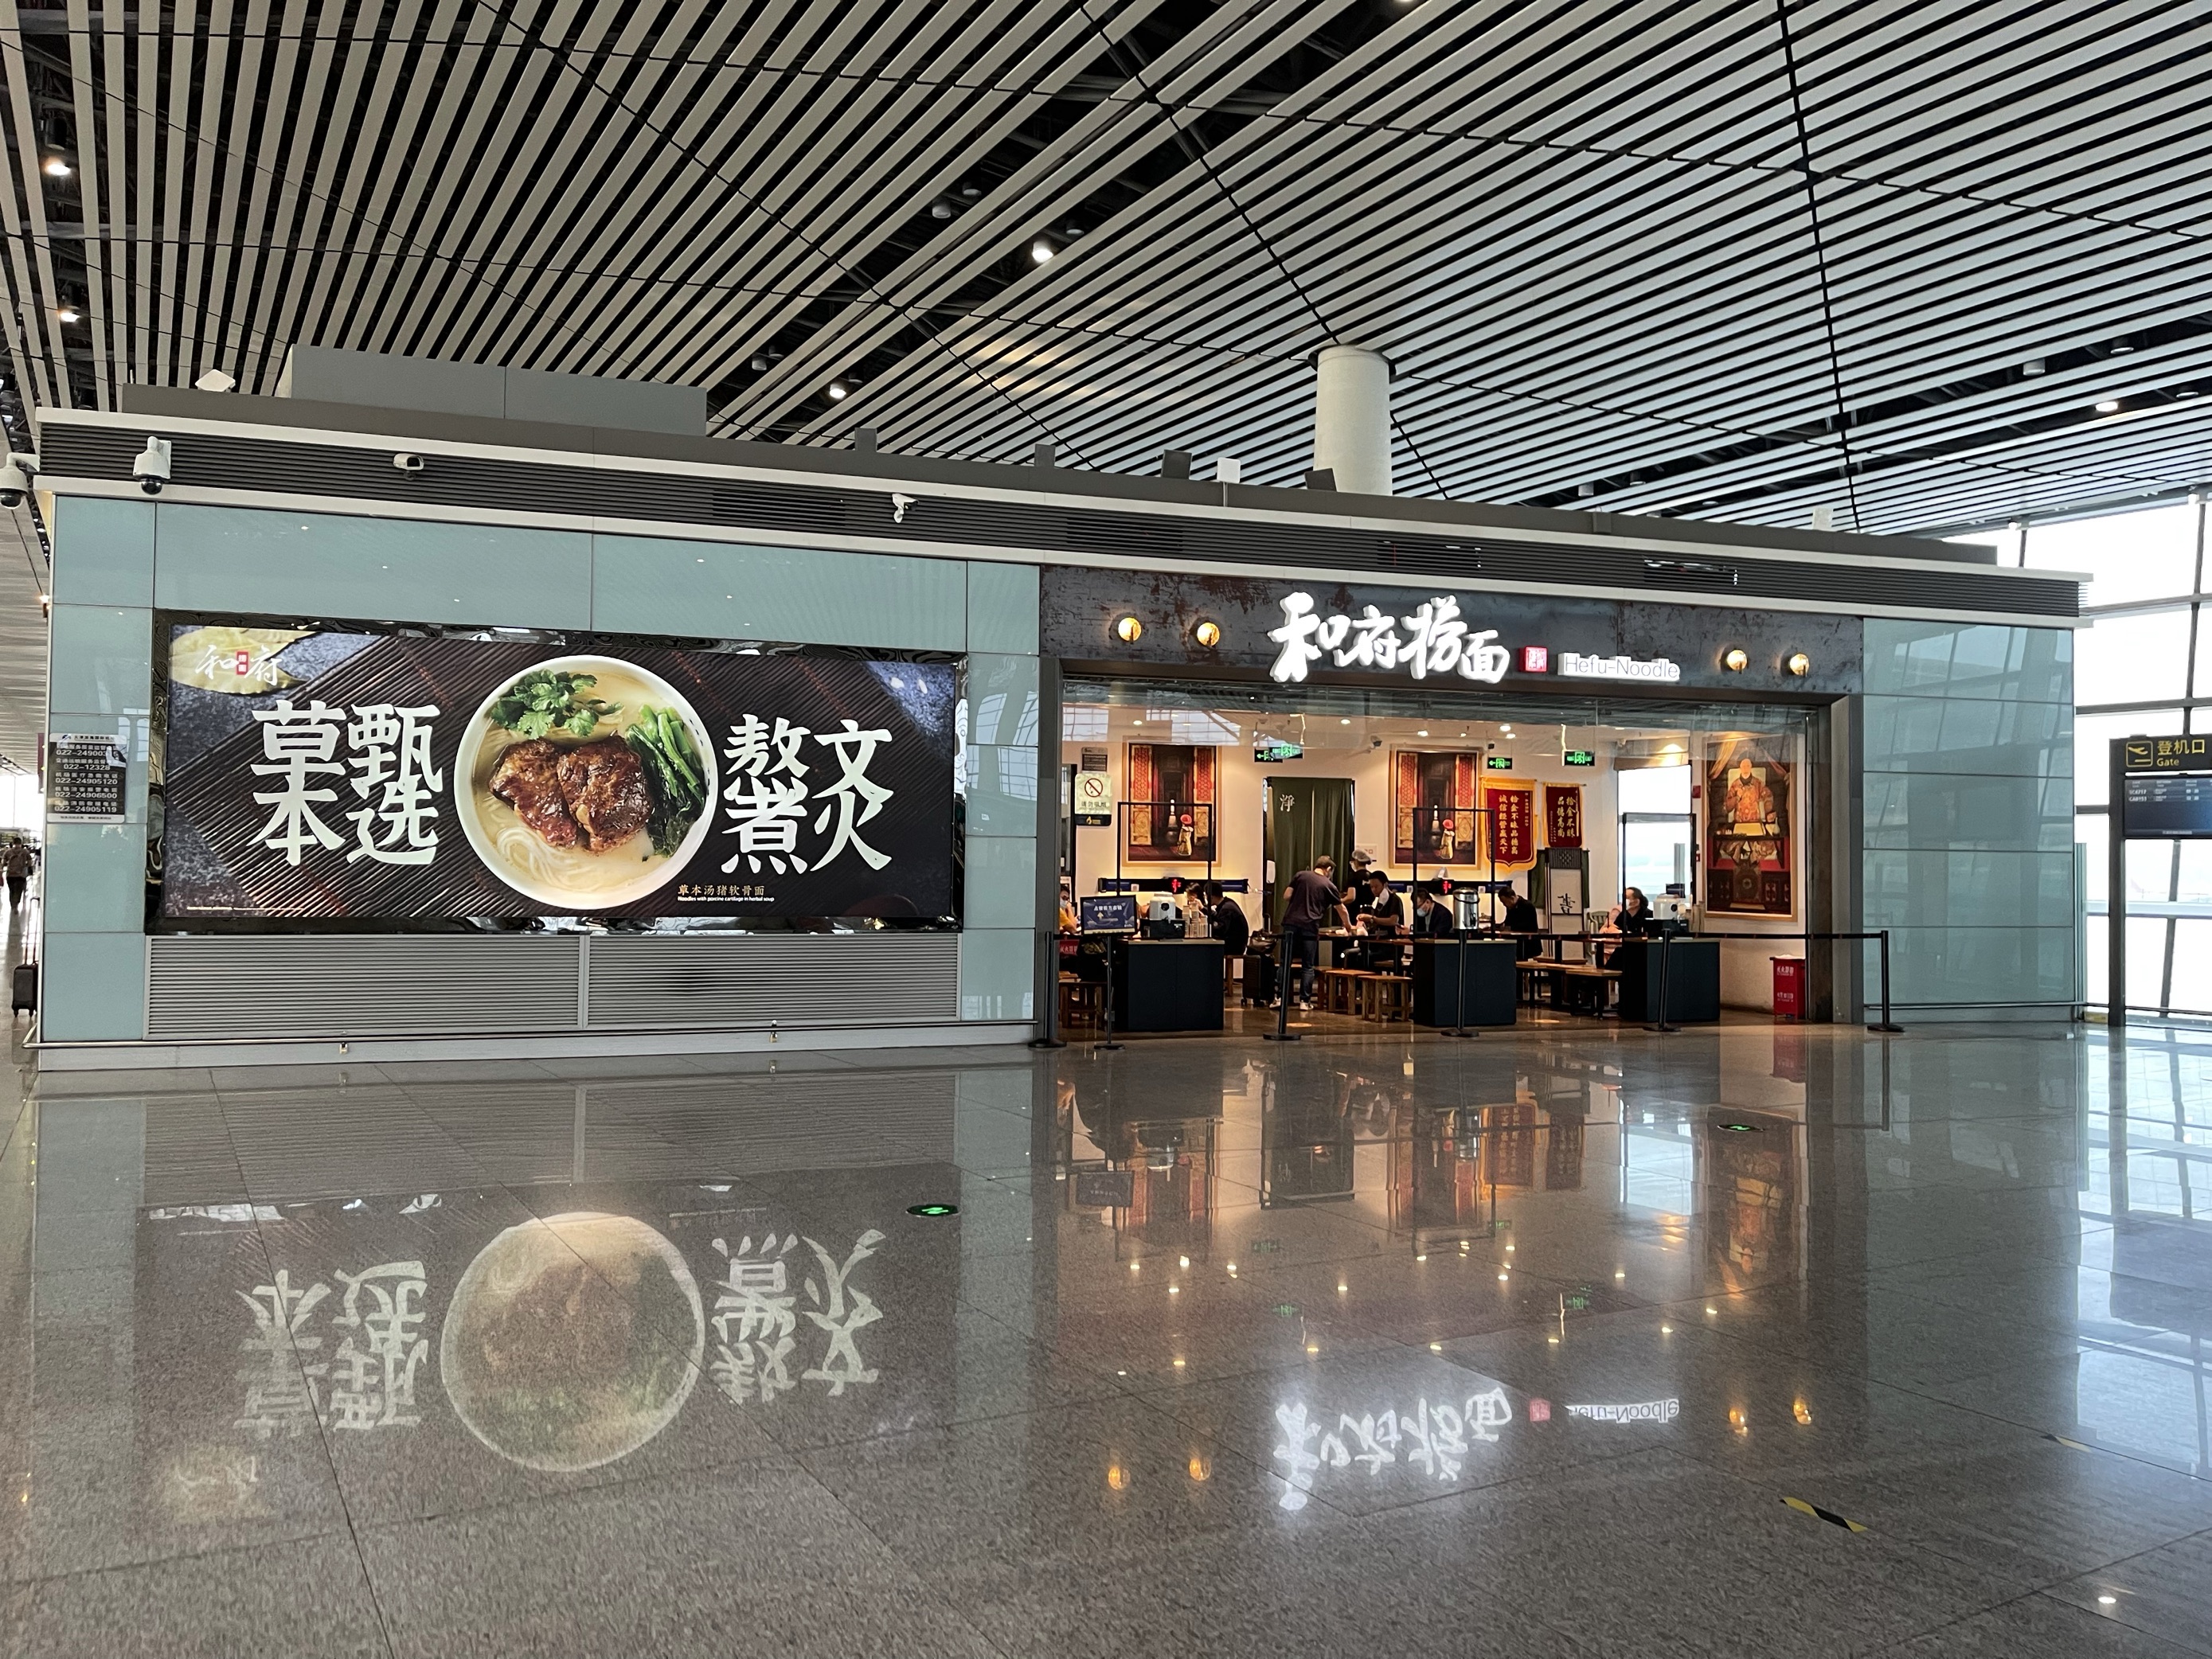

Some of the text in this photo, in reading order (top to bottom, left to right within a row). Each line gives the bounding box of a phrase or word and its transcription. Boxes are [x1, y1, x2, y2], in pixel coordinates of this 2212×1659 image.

[1267, 591, 1510, 685] 和府捞面
[1562, 654, 1680, 681] Hefu-Noodle
[2157, 739, 2206, 755] 登机口
[2156, 758, 2180, 767] Gate
[678, 884, 764, 896] 草本汤猪软骨面
